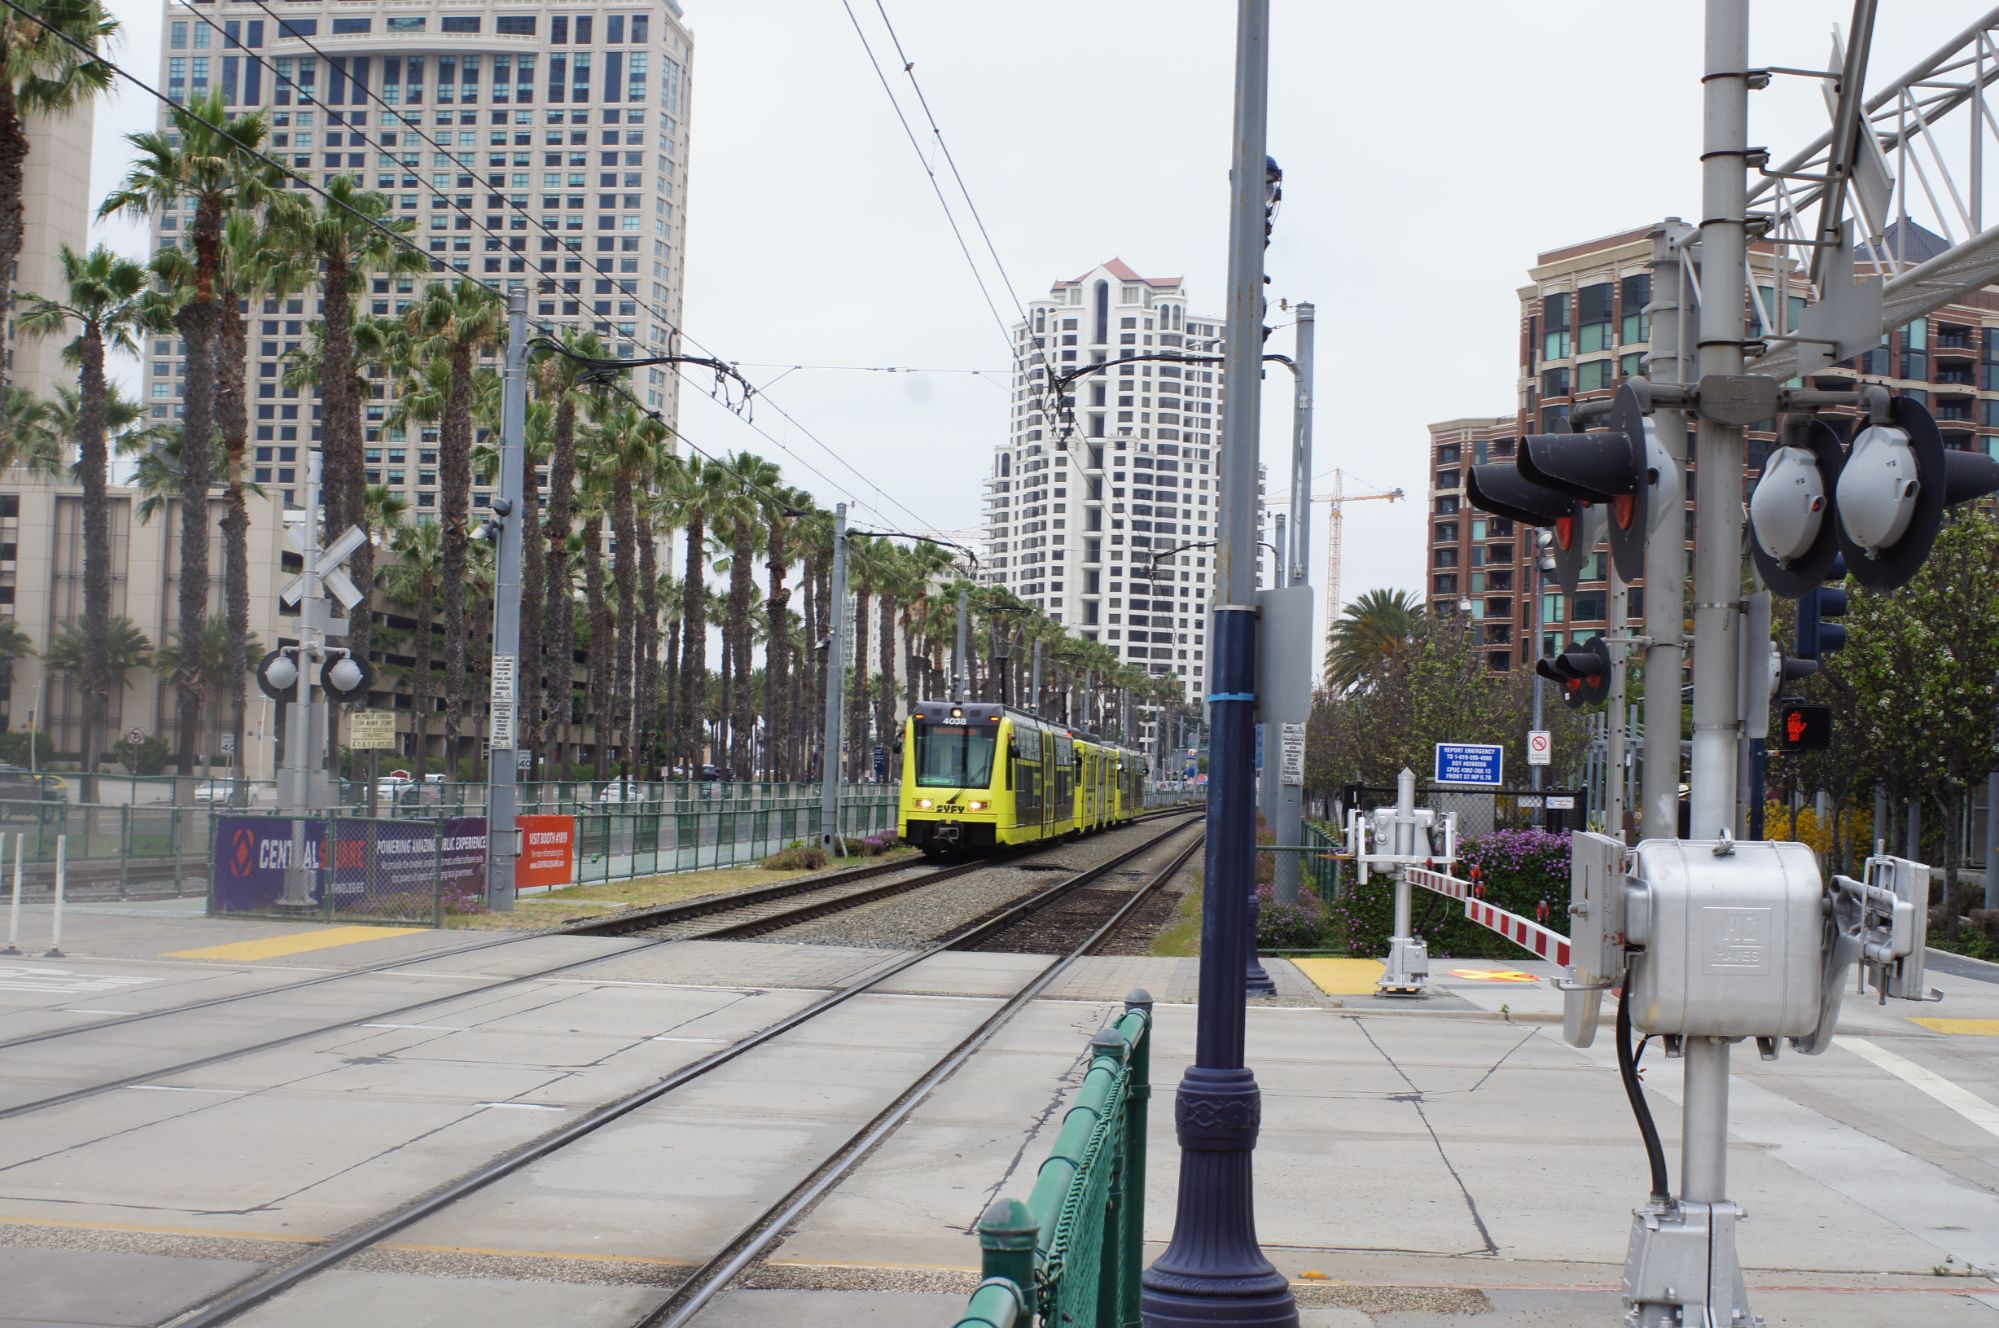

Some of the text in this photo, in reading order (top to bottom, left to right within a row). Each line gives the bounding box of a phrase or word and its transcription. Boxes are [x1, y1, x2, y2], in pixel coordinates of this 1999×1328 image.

[222, 744, 236, 752] 40
[519, 760, 531, 768] 40
[377, 839, 412, 854] POWERING
